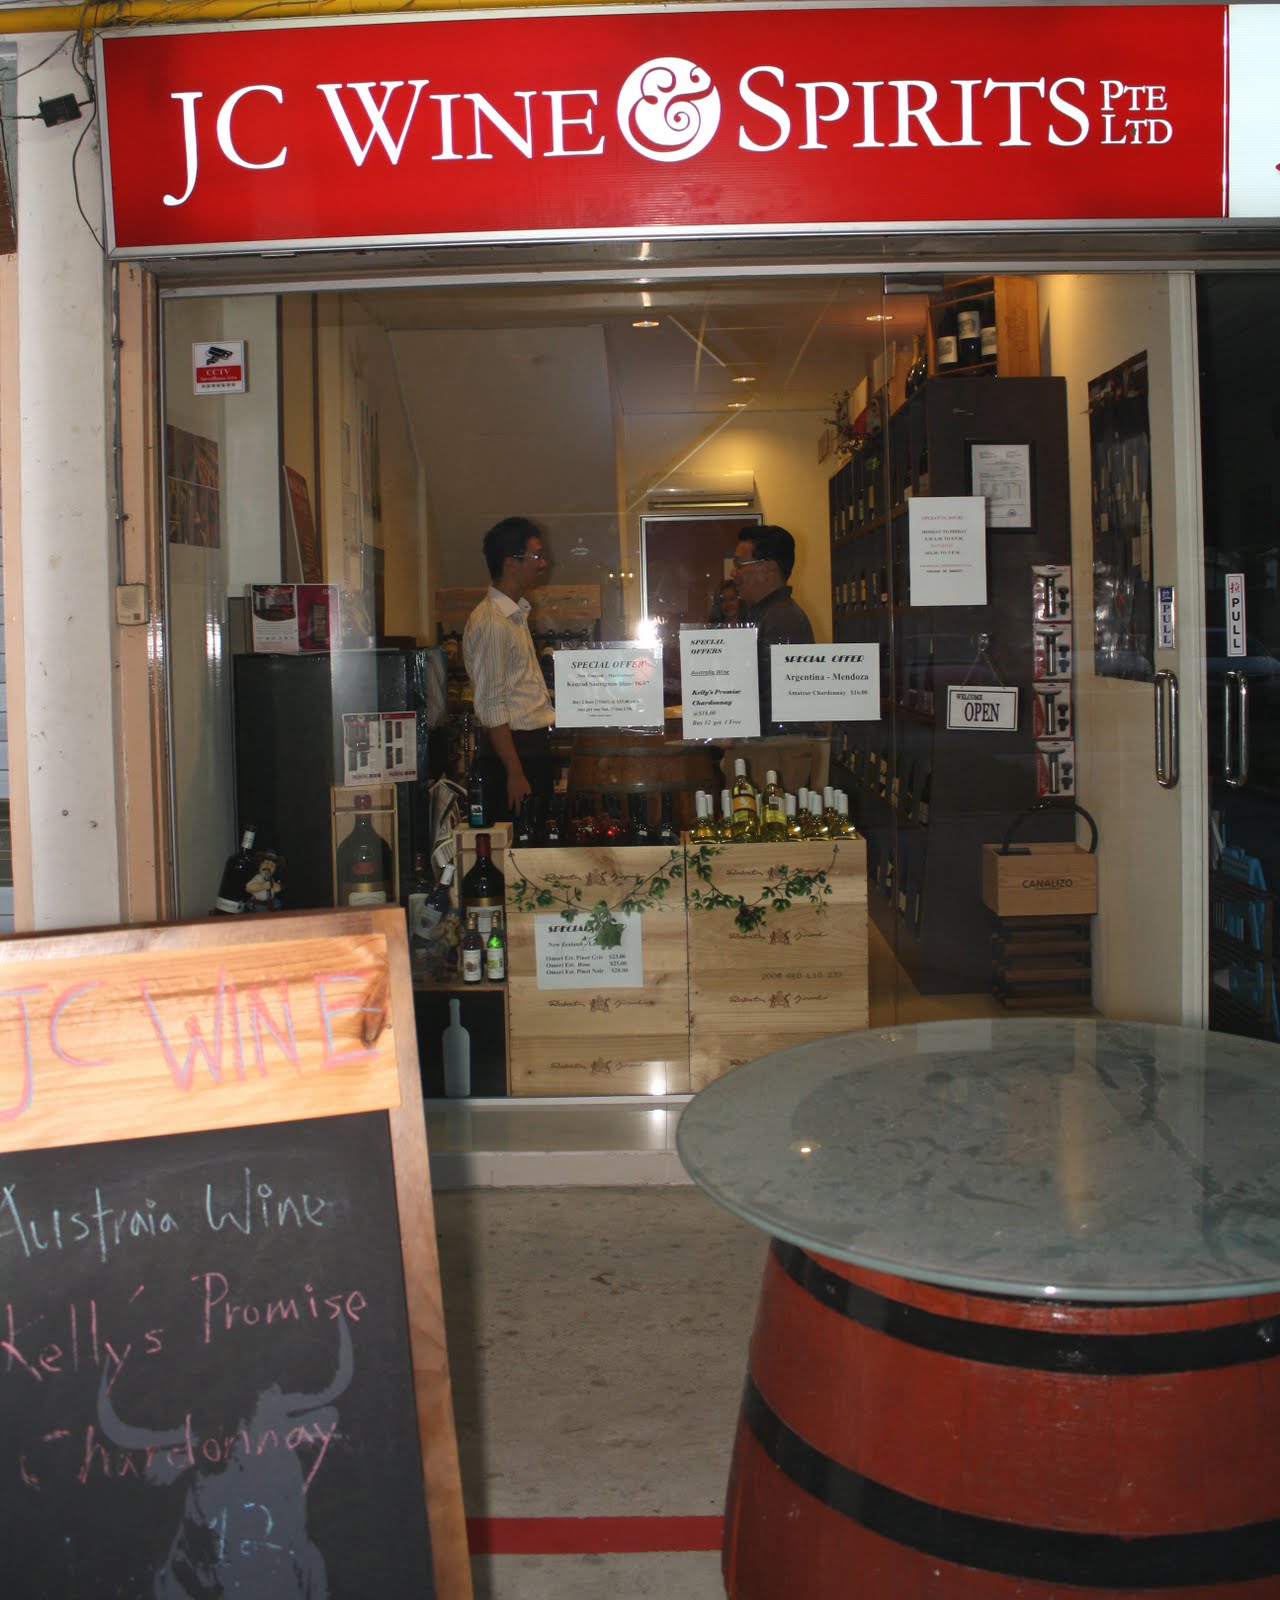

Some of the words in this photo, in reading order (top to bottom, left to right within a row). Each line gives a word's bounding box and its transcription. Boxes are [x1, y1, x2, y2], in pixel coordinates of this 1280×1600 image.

[1101, 79, 1168, 112] PTE
[163, 85, 287, 206] JC
[317, 79, 605, 167] WINE
[617, 57, 721, 162] &
[739, 66, 1090, 152] SPIRITS
[1101, 114, 1173, 145] LTD
[206, 368, 230, 376] CCTV
[1163, 604, 1172, 644] PULL
[1231, 597, 1241, 648] PULL
[570, 660, 610, 669] SPECIAL
[612, 660, 645, 669] OFFER
[784, 655, 827, 663] SPECIAL
[831, 654, 865, 663] OFFER
[784, 673, 825, 682] Argentina
[964, 702, 1000, 722] OPEN
[1022, 878, 1073, 888] CANALIZO
[0, 981, 113, 1122] JC
[137, 963, 384, 1092] WINE
[205, 1167, 328, 1235] Wine
[1, 1285, 164, 1398] Kelly's
[191, 1271, 367, 1345] Promise
